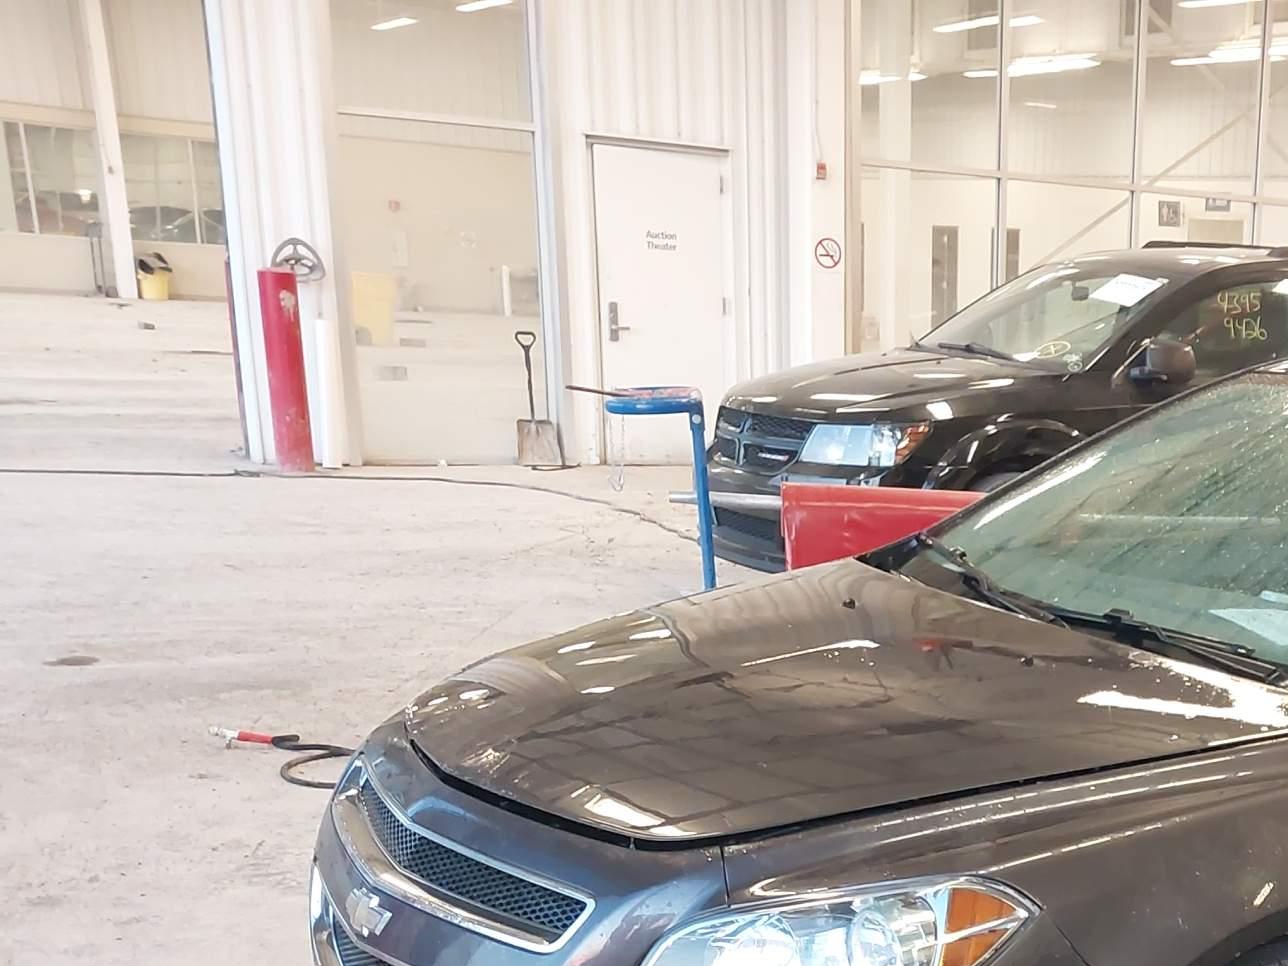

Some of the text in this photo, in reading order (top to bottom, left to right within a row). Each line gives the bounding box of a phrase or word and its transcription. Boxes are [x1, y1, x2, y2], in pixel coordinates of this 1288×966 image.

[646, 230, 678, 241] Auction
[1217, 291, 1262, 314] 4395
[1223, 315, 1268, 341] 9426
